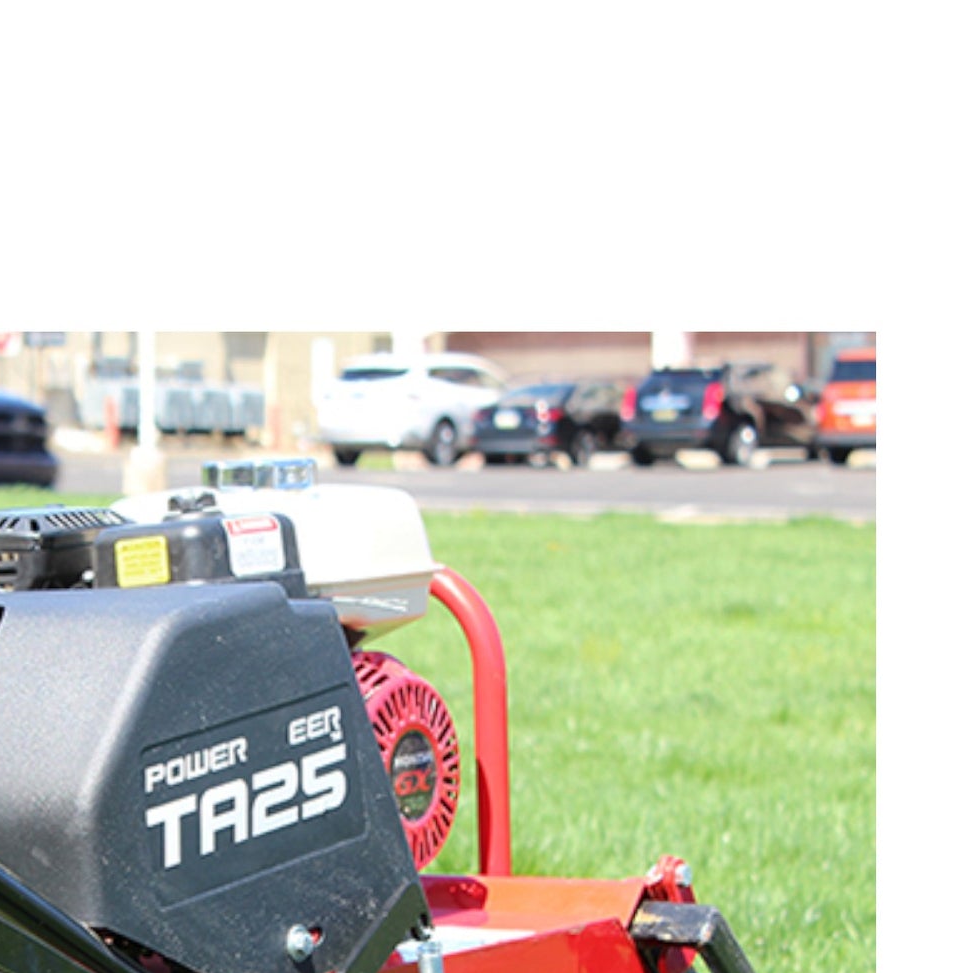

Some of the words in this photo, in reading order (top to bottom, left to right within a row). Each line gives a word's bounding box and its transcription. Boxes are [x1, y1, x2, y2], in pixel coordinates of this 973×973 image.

[145, 738, 248, 793] POWER
[395, 768, 432, 797] GX
[146, 744, 347, 869] TA25
